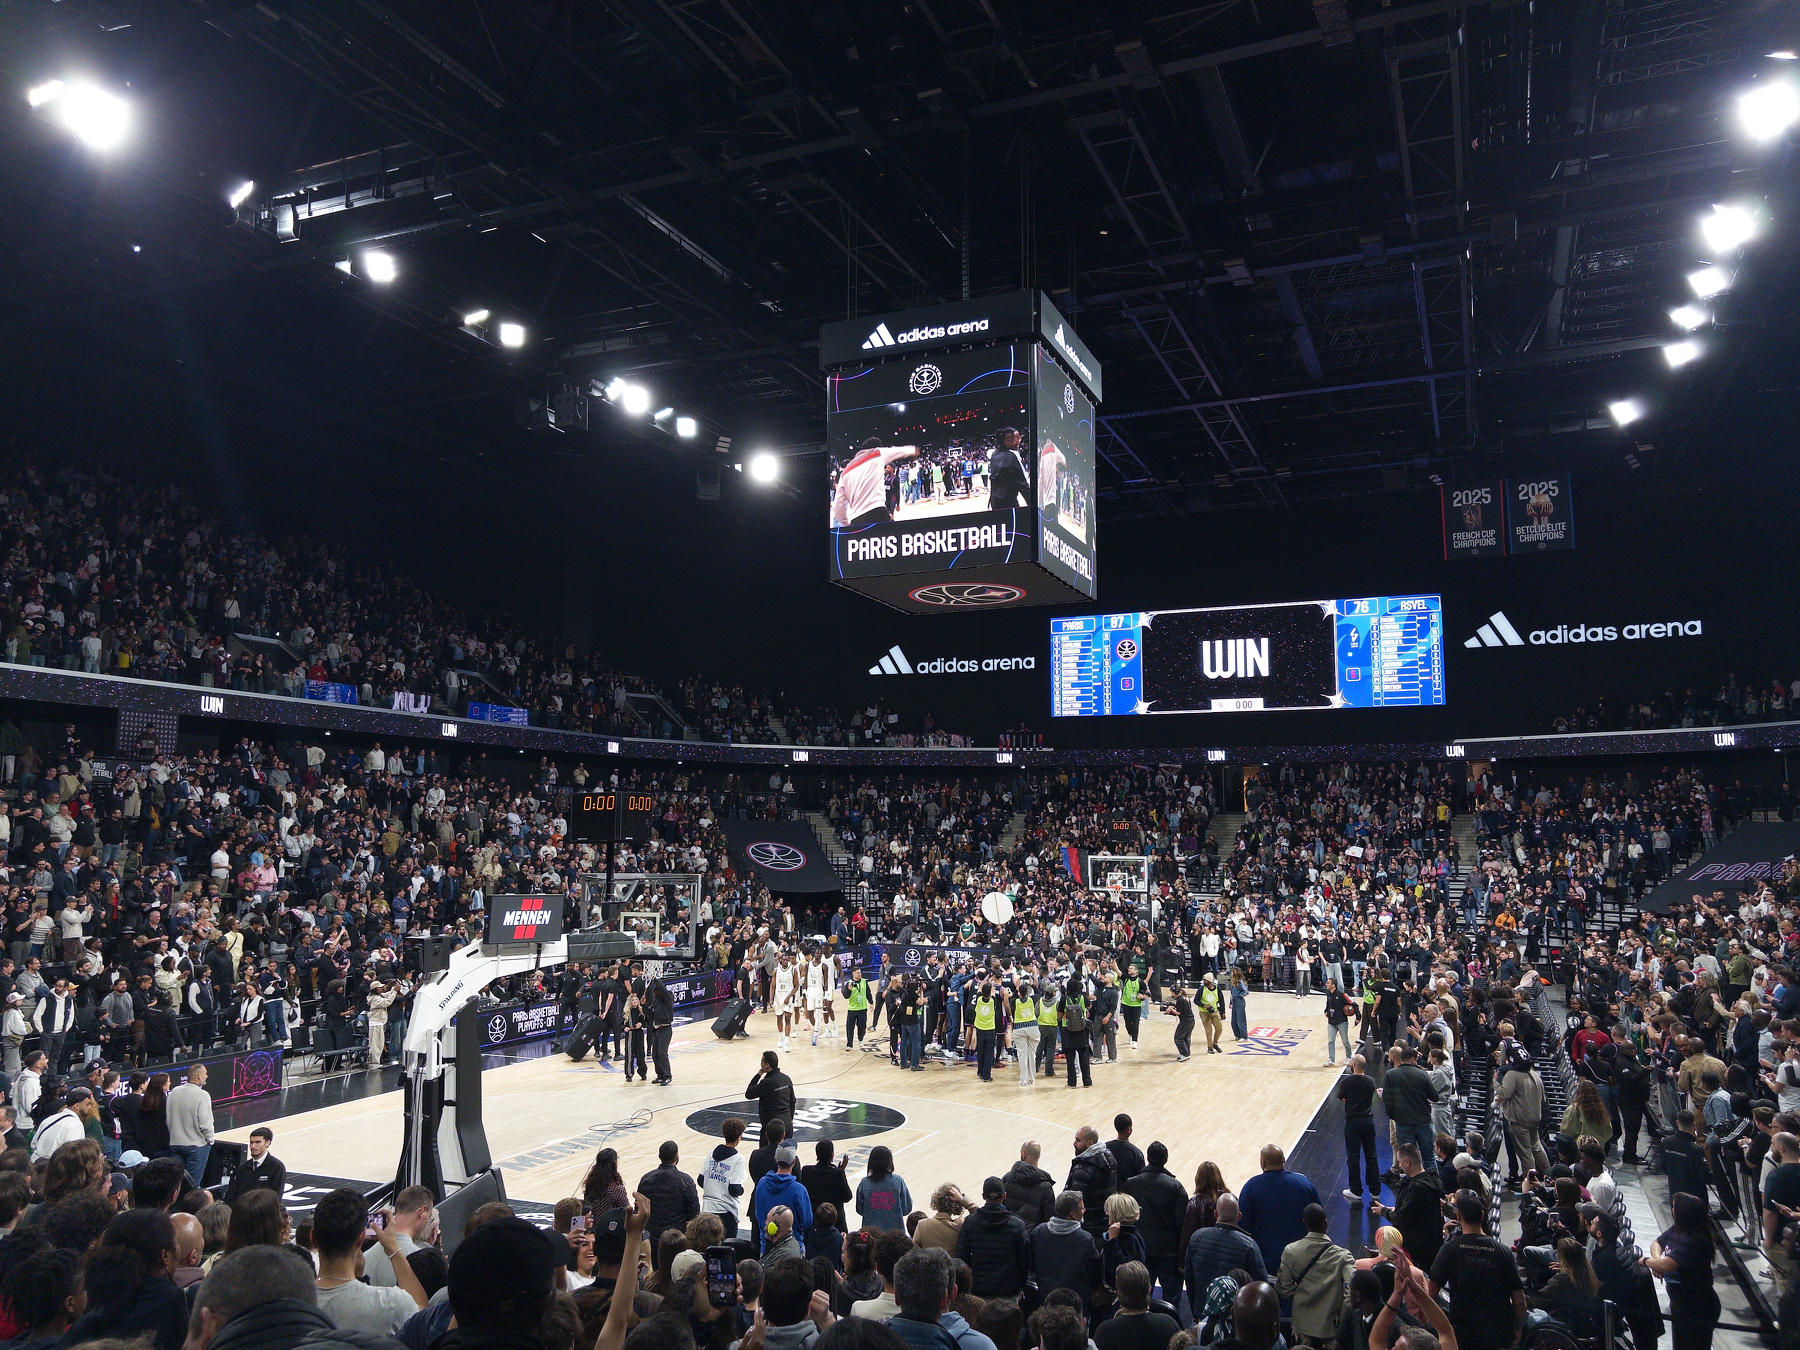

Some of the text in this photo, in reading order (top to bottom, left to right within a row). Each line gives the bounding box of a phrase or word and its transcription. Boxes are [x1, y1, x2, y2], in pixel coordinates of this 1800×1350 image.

[898, 319, 989, 344] adidas arena
[1518, 480, 1559, 500] 2025
[1452, 488, 1492, 508] 2025
[1452, 530, 1496, 540] FRENCH CUP
[1516, 522, 1566, 535] BETCLIC ELITE
[848, 524, 1012, 561] PARIS BASKETBALL
[1453, 538, 1496, 548] CHAMPIONS
[1520, 531, 1564, 542] CHAMPIONS
[1044, 526, 1092, 580] PARIS BASKETBALL
[1354, 600, 1427, 614] 76 ASVEL
[1062, 616, 1124, 631] PARIS 87
[1528, 620, 1702, 646] adidas arena
[917, 656, 1035, 674] adidas arena
[1202, 638, 1270, 679] WIN
[1350, 670, 1357, 678] 5
[201, 696, 224, 714] WIN
[442, 722, 458, 737] WIN
[1714, 732, 1734, 746] WIN
[607, 741, 619, 754] WIN
[1446, 746, 1465, 757] WIN
[793, 751, 808, 762] WIN
[996, 753, 1012, 764] WIN
[1208, 750, 1225, 761] WIN
[584, 796, 615, 810] 0:00
[629, 796, 652, 811] 0:00
[503, 910, 552, 926] MENNEN
[438, 980, 464, 1011] SPALDING
[512, 1010, 528, 1023] PARIS
[518, 1019, 544, 1033] PLAYOFFS
